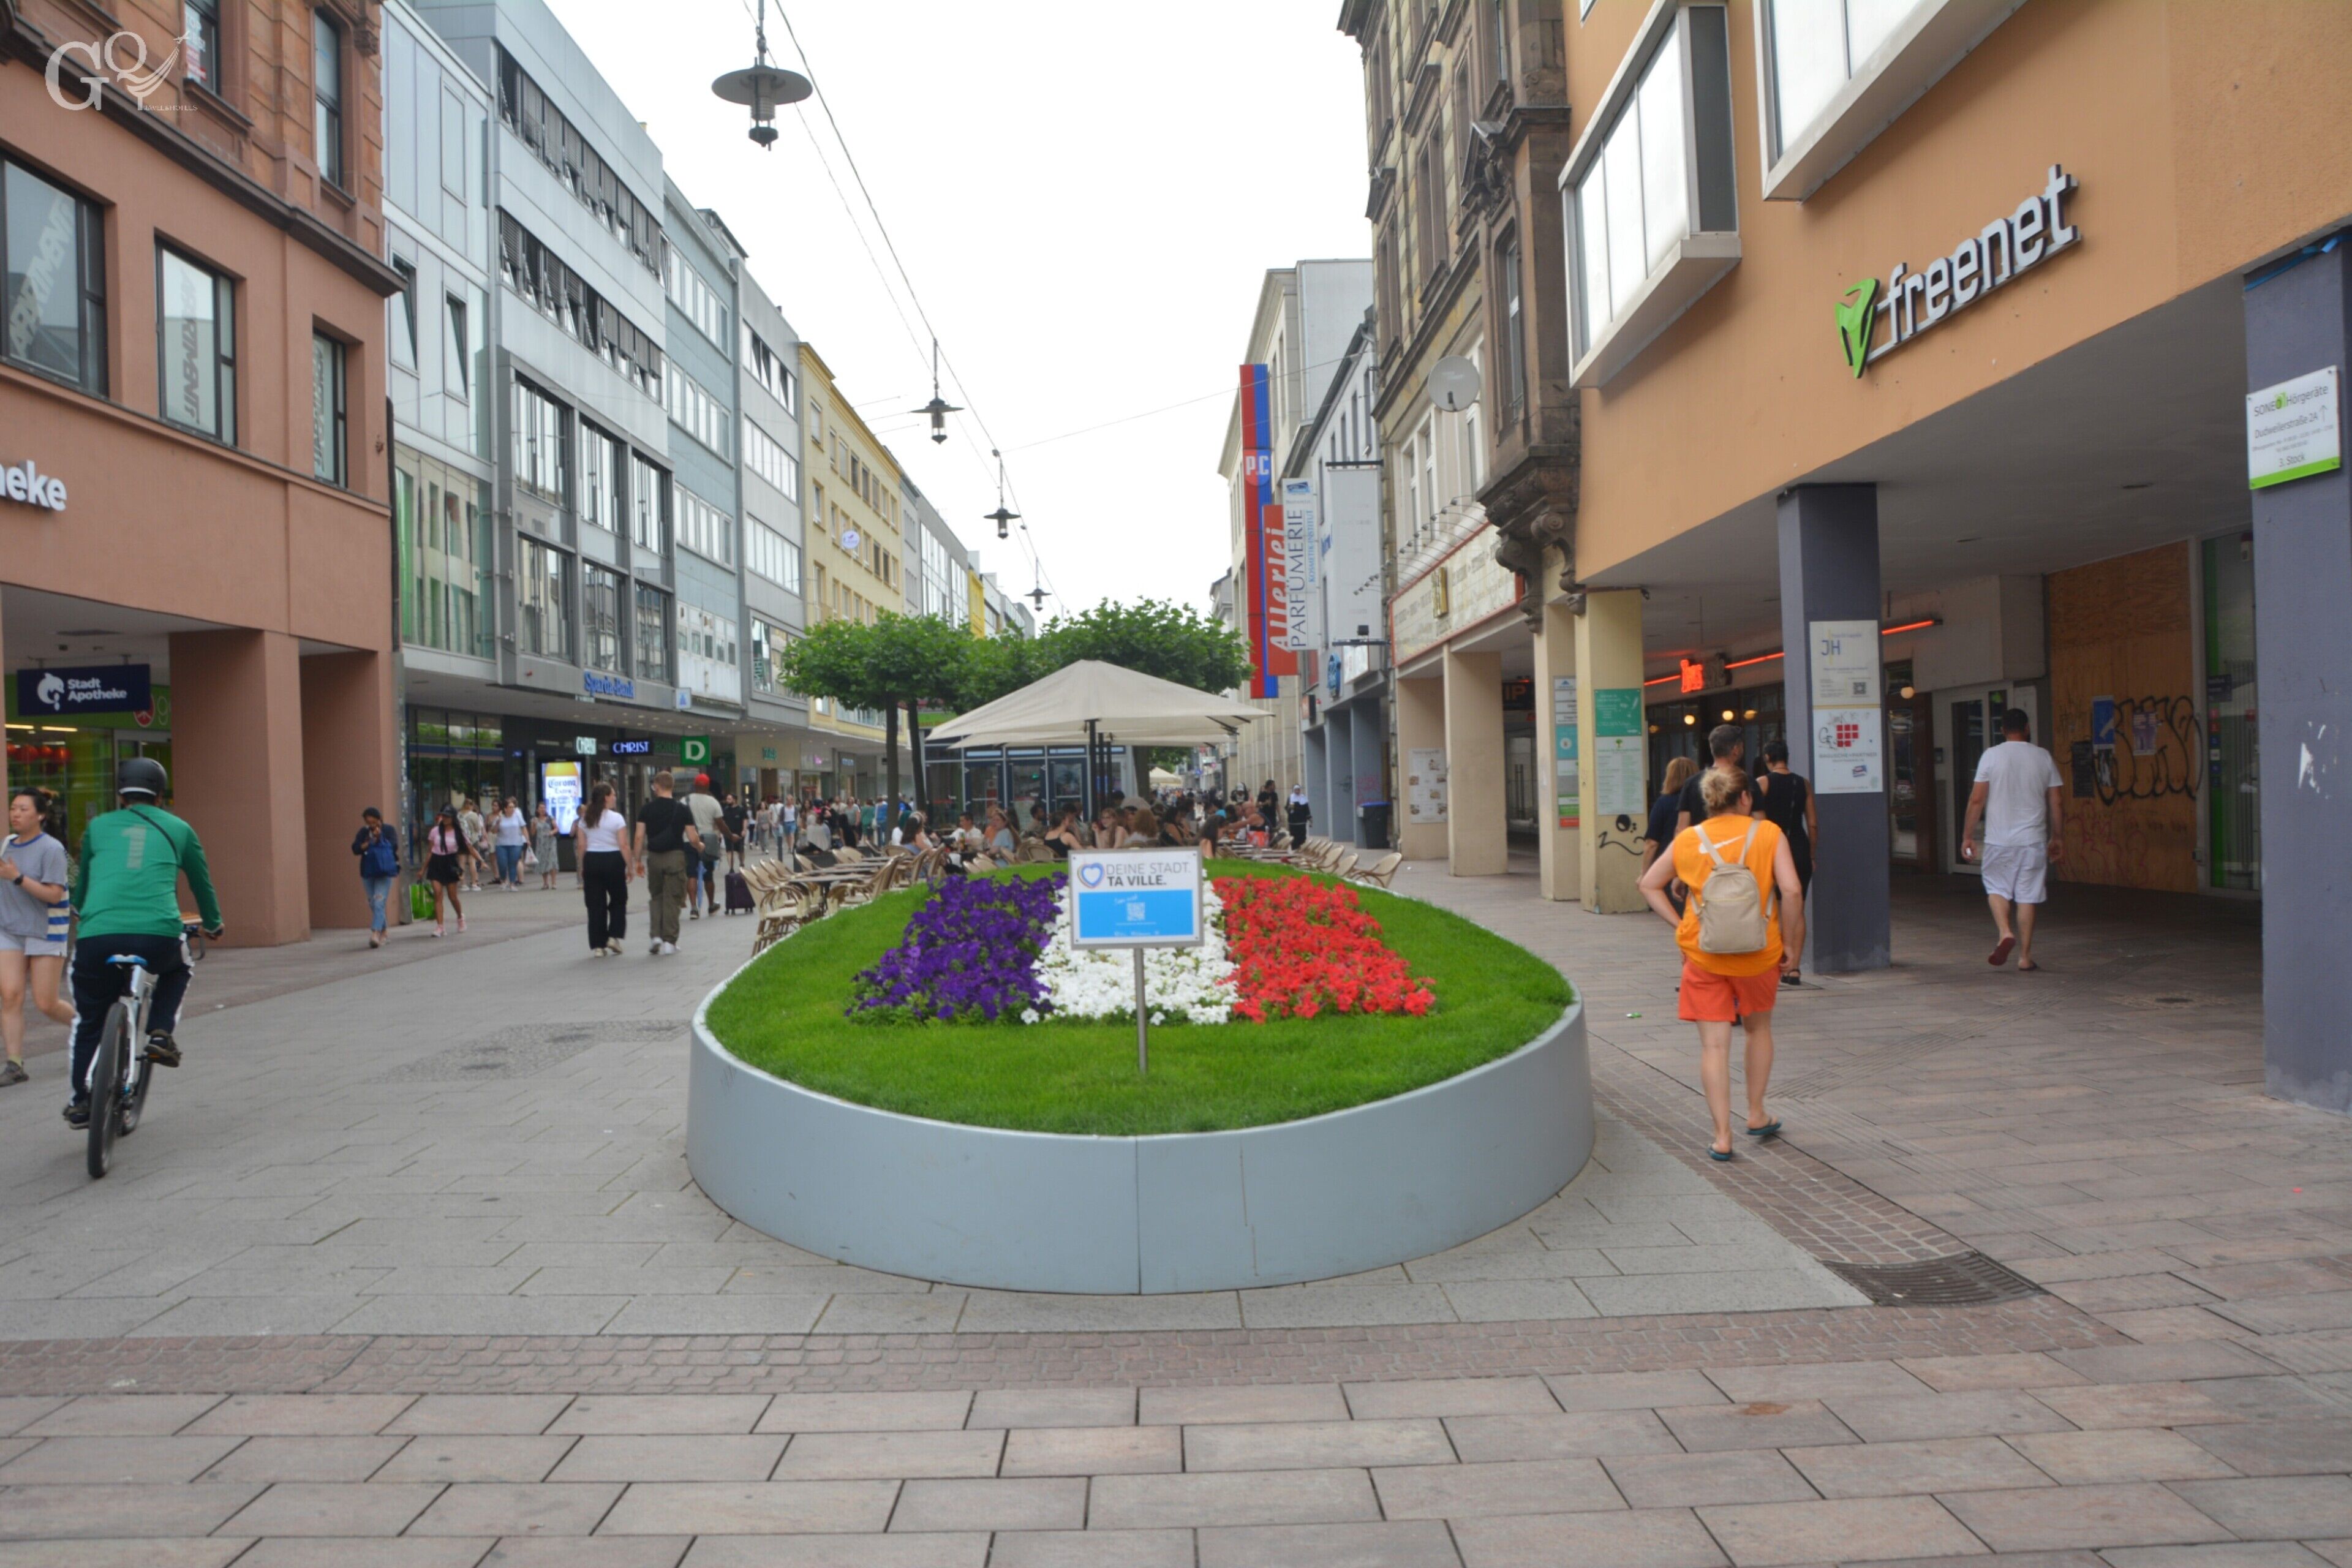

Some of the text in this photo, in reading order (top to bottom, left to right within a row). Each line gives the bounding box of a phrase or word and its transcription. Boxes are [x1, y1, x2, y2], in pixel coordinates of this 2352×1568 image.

[1888, 164, 2078, 345] freenet
[2286, 386, 2328, 407] Hörgeräte
[2255, 415, 2308, 439] Dudweilerstraße
[2286, 452, 2306, 466] Stock
[0, 460, 67, 511] eke
[1287, 510, 1306, 647] PARFÜMERIE
[1266, 528, 1291, 653] Allerlei
[1821, 639, 1841, 656] JH
[67, 677, 102, 690] Stadt
[67, 688, 127, 703] Apotheke
[612, 741, 649, 754] CHRIST
[685, 740, 706, 761] D
[1106, 861, 1191, 875] DEINE STADT.
[1107, 875, 1167, 887] TA VILLE.
